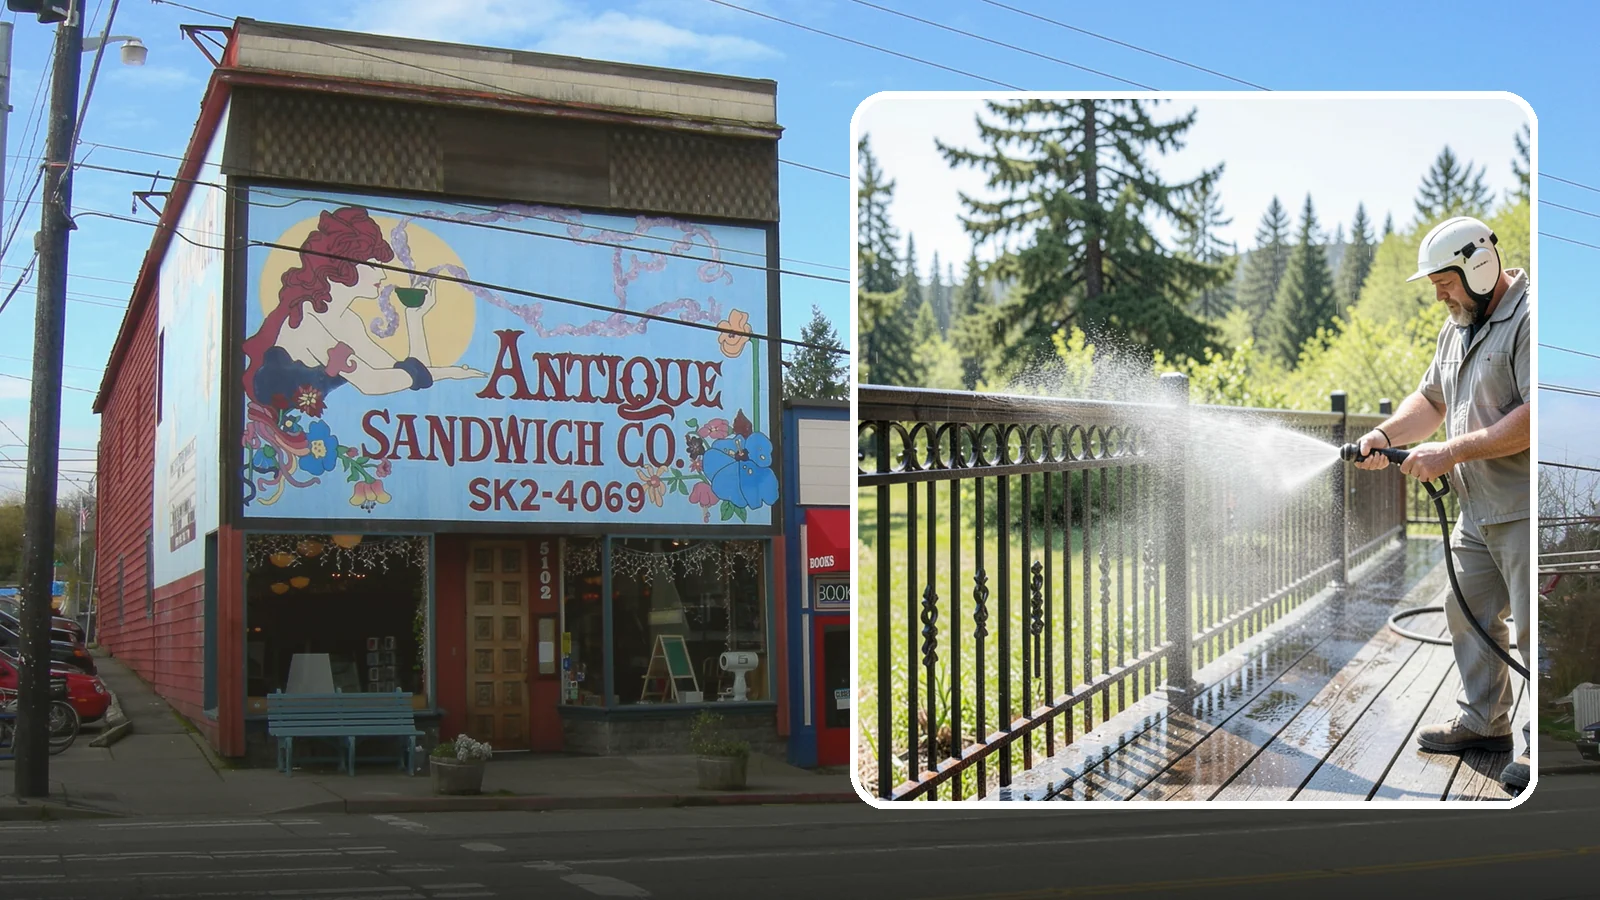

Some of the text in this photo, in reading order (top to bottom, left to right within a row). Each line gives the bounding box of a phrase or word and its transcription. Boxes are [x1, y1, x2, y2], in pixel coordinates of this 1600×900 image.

[476, 329, 724, 420] ANTIQUE
[361, 409, 685, 467] SANDWICH CO.
[468, 477, 646, 512] SK2-4069
[540, 541, 551, 600] 5102
[809, 555, 834, 569] BOOKS
